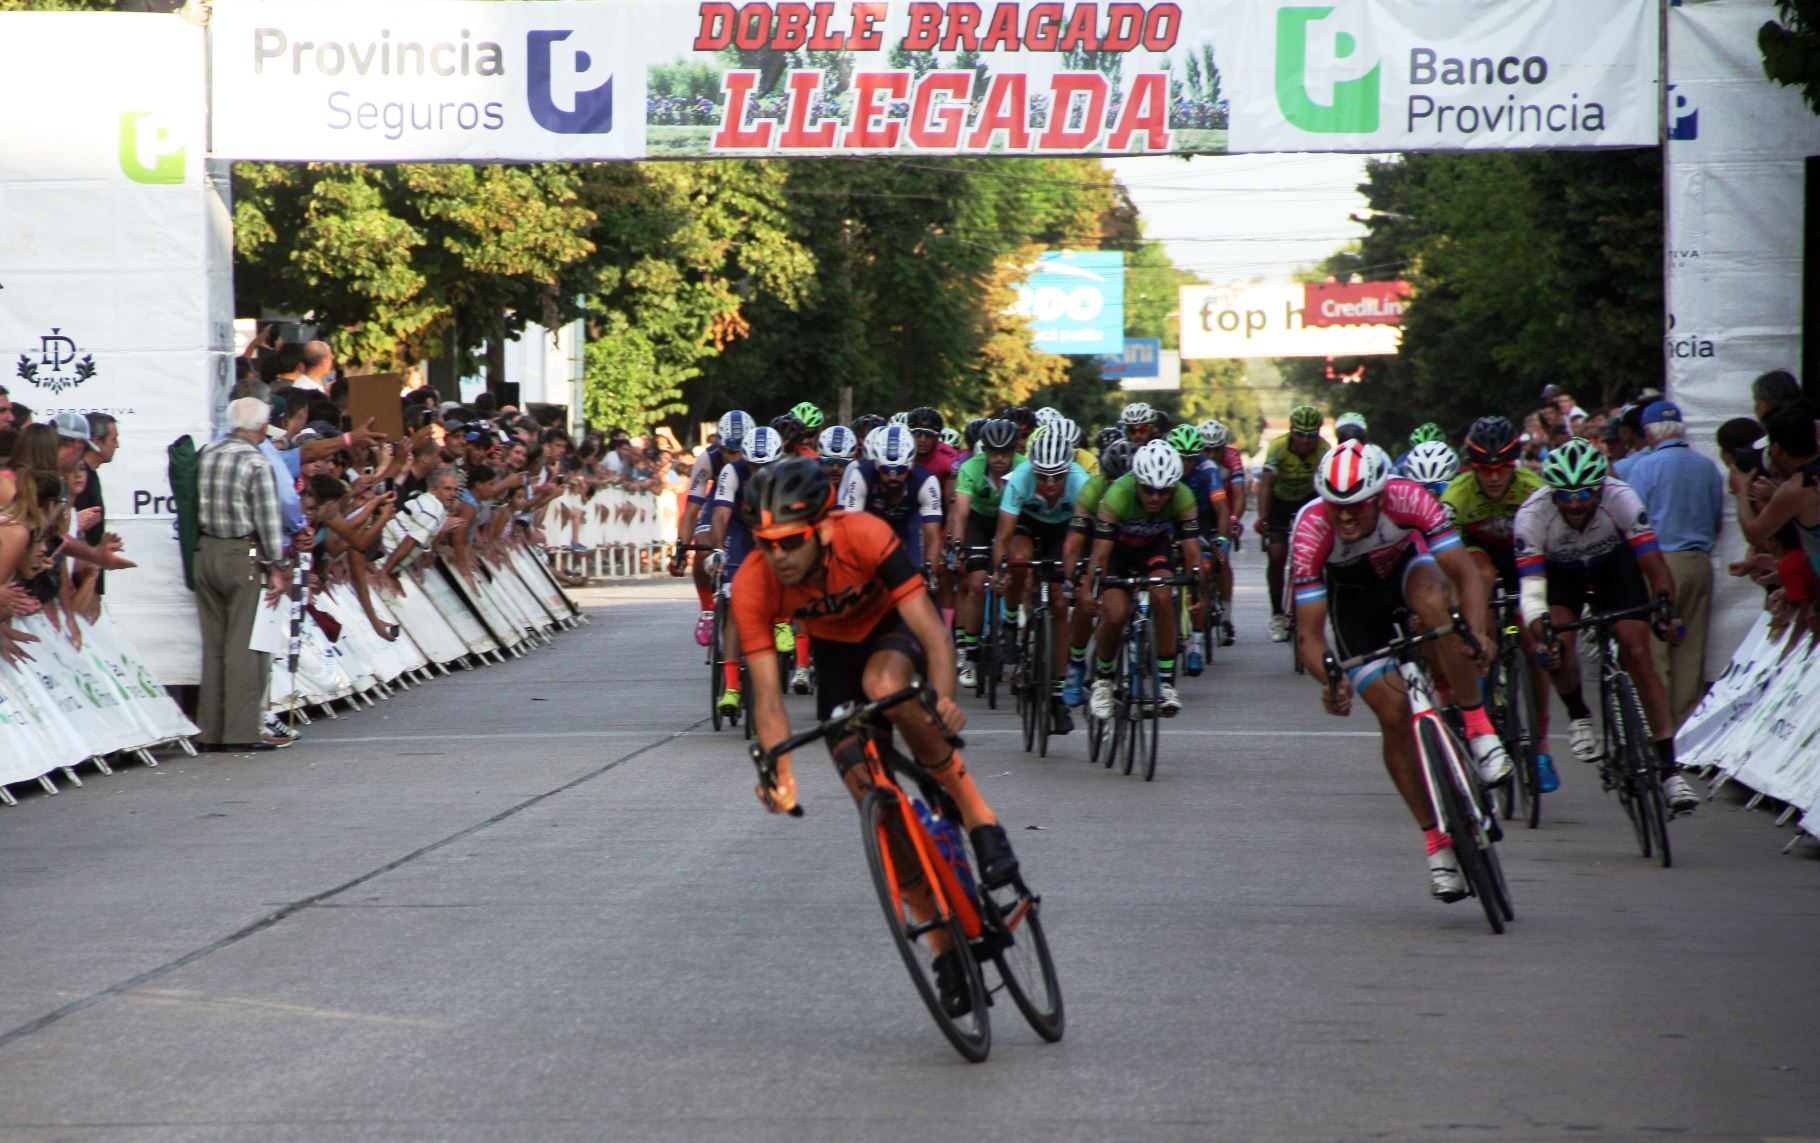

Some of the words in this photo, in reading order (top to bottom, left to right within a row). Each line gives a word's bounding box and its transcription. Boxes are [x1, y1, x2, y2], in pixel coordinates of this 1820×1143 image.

[694, 2, 887, 51] DOBLE
[902, 2, 1182, 52] BRAGADO
[253, 28, 504, 76] Provincia
[1409, 47, 1548, 85] Banco
[327, 91, 504, 139] Seguros
[713, 69, 1173, 153] LLEGADA
[1407, 92, 1606, 134] Provincia
[1199, 301, 1267, 338] top
[1321, 297, 1406, 317] CrediLin
